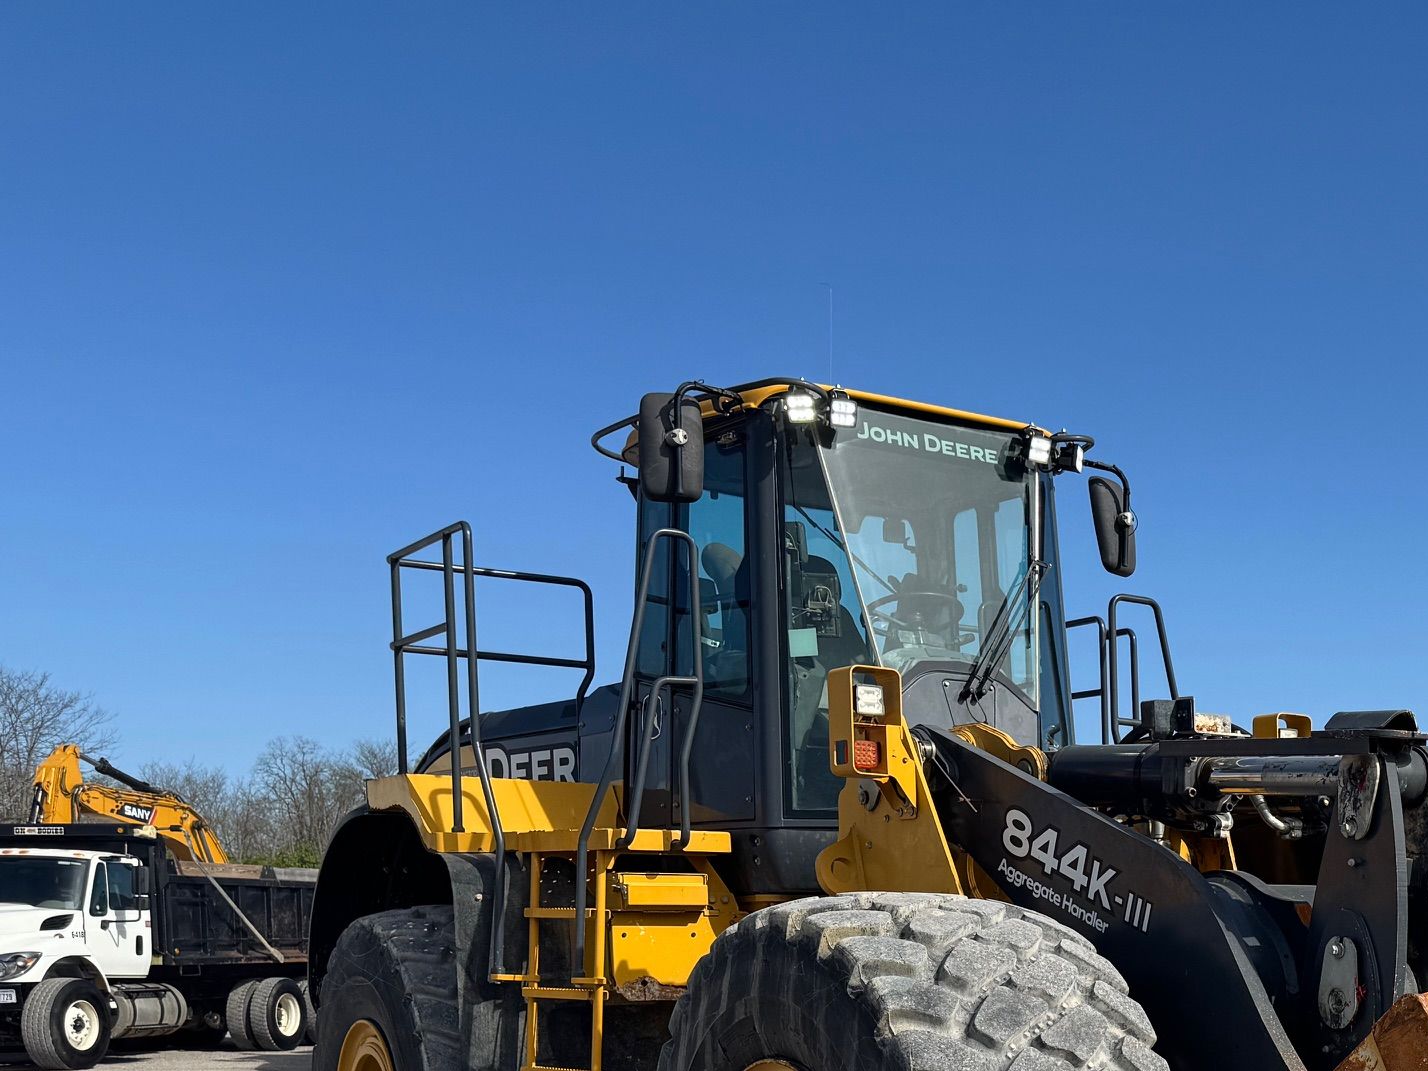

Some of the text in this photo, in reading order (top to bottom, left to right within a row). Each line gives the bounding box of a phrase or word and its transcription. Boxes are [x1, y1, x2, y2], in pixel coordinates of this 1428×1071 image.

[857, 421, 999, 465] JOHN DEERE
[124, 804, 151, 820] SANY
[997, 857, 1110, 934] Aggregate Handler
[1002, 808, 1152, 933] 844K-III
